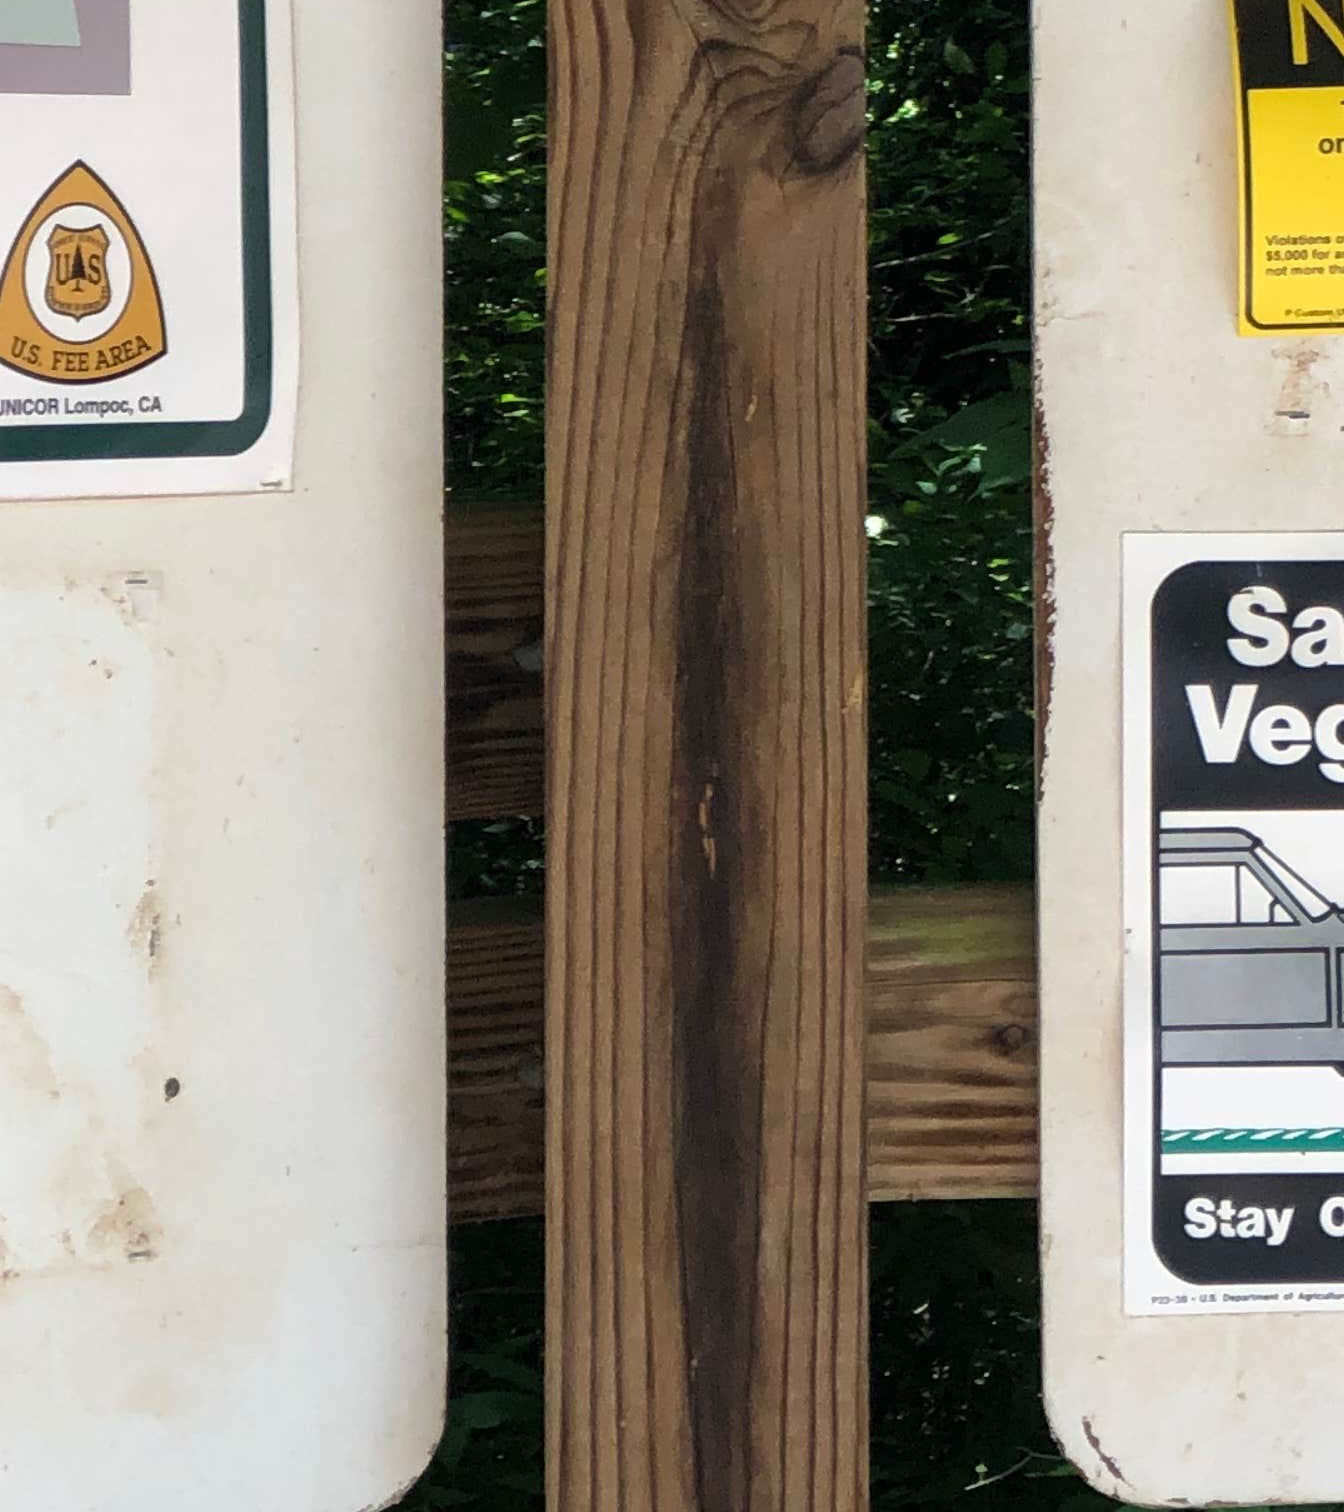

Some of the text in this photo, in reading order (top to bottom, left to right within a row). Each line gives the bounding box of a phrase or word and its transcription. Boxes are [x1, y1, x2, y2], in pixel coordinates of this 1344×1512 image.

[1265, 234, 1331, 246] Violations
[1311, 248, 1331, 261] for
[1265, 265, 1288, 277] not
[1290, 265, 1326, 276] more
[11, 334, 152, 373] U.S. FEE AREA
[64, 398, 134, 418] Lompoc,
[138, 395, 162, 413] CA
[1184, 1197, 1295, 1246] Stay
